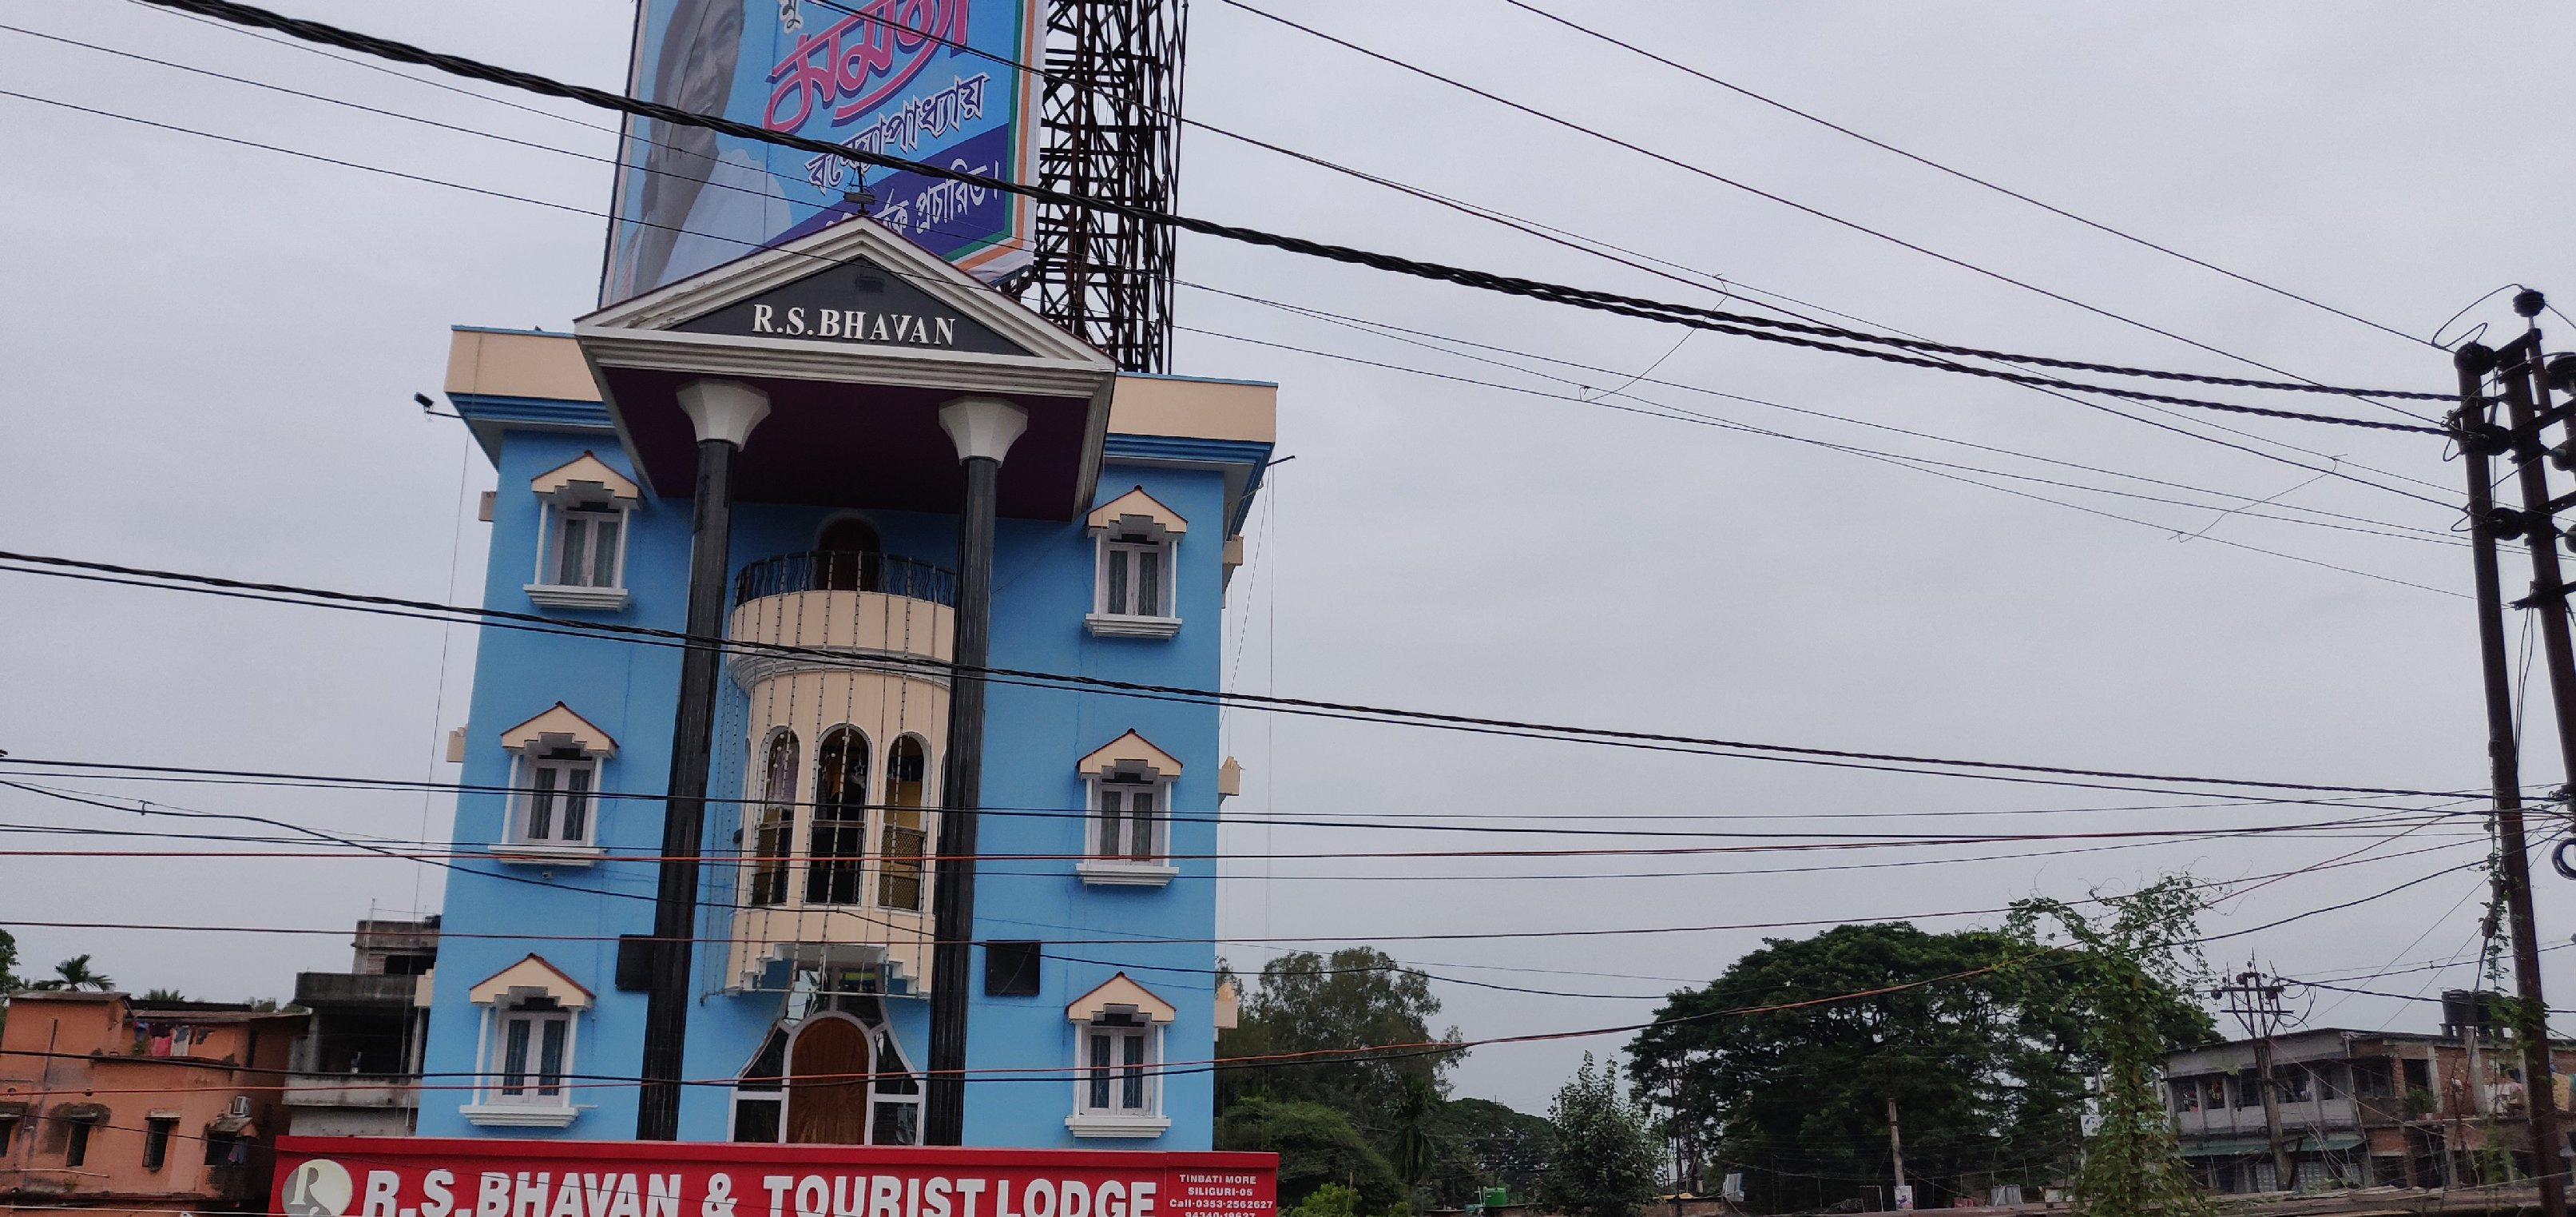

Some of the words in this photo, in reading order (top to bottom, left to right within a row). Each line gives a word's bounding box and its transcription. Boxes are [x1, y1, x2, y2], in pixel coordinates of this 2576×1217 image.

[752, 304, 956, 346] R.S.BHAVAN
[1180, 1174, 1222, 1183] TINBATI
[1225, 1175, 1256, 1184] MORE
[1188, 1187, 1253, 1196] SILIGURI-05
[362, 1169, 681, 1217] R.S.BHAVAN
[701, 1173, 737, 1217] &
[763, 1175, 986, 1217] TOURIST
[997, 1179, 1157, 1217] LODGE
